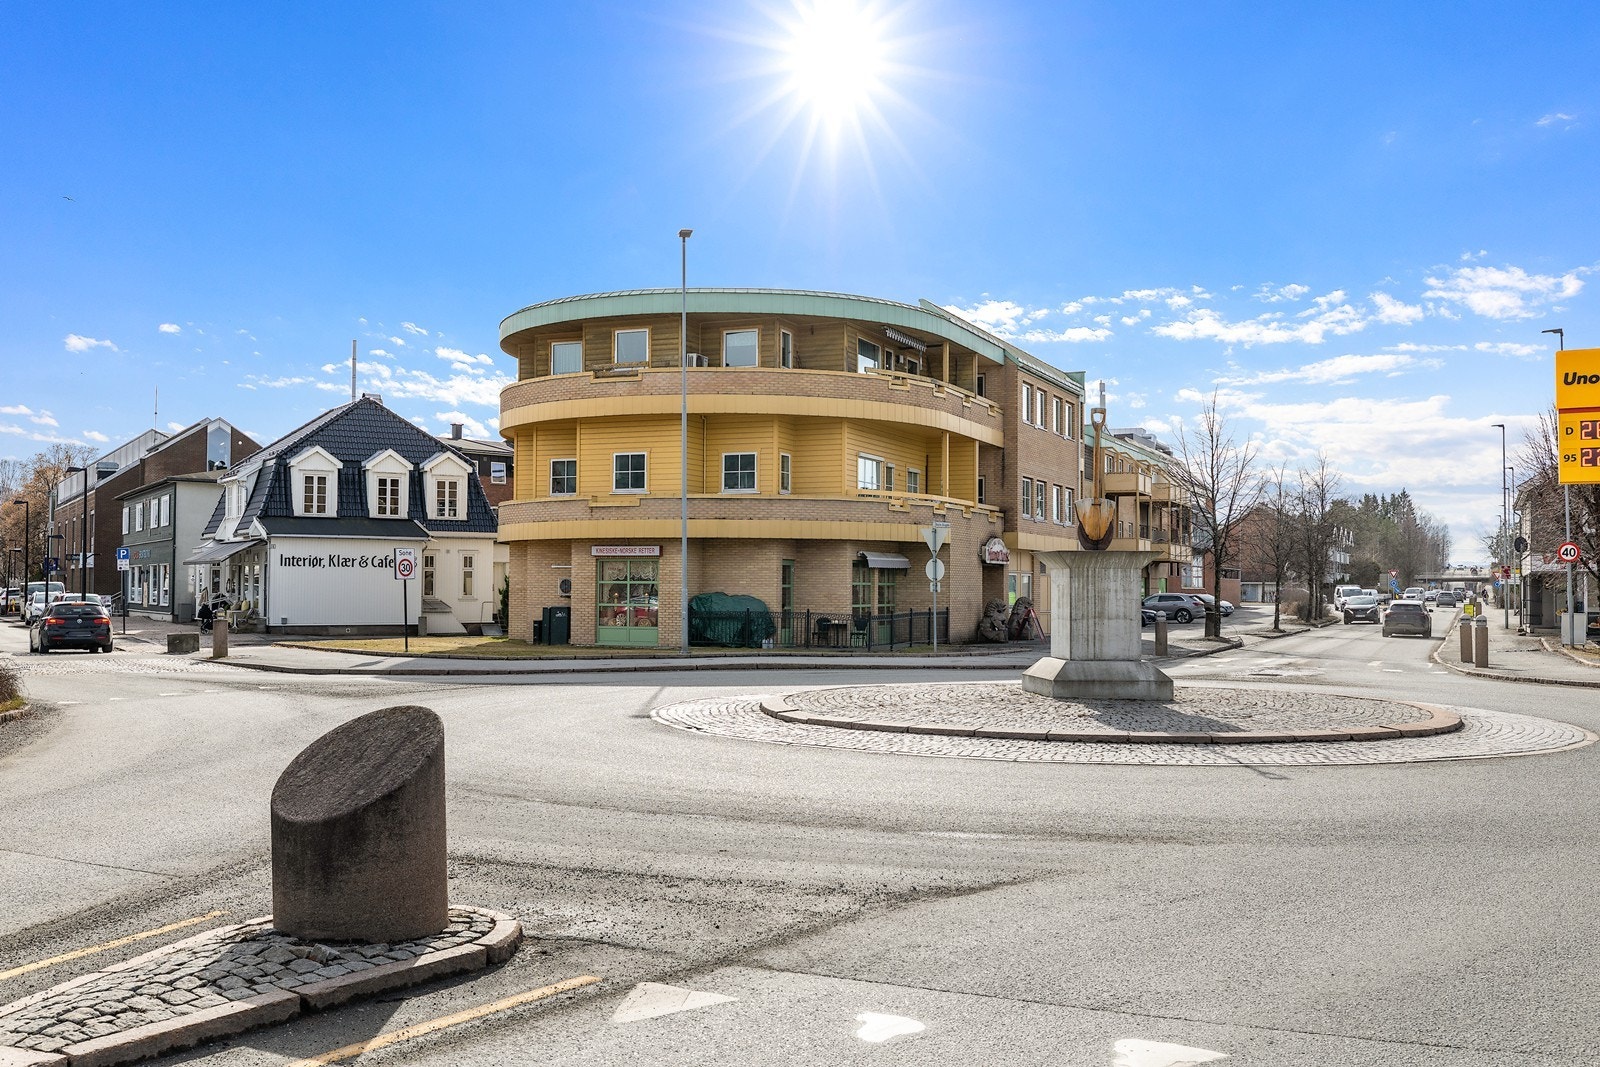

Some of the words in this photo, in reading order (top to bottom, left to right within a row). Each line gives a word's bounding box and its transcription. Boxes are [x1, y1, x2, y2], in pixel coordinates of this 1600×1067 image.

[1565, 426, 1574, 436] D
[1563, 453, 1577, 463] 95
[120, 549, 127, 559] P
[1561, 547, 1576, 557] 40
[280, 553, 325, 568] Interiør,
[328, 554, 357, 568] Klær
[358, 555, 369, 568] &
[401, 563, 411, 572] 30
